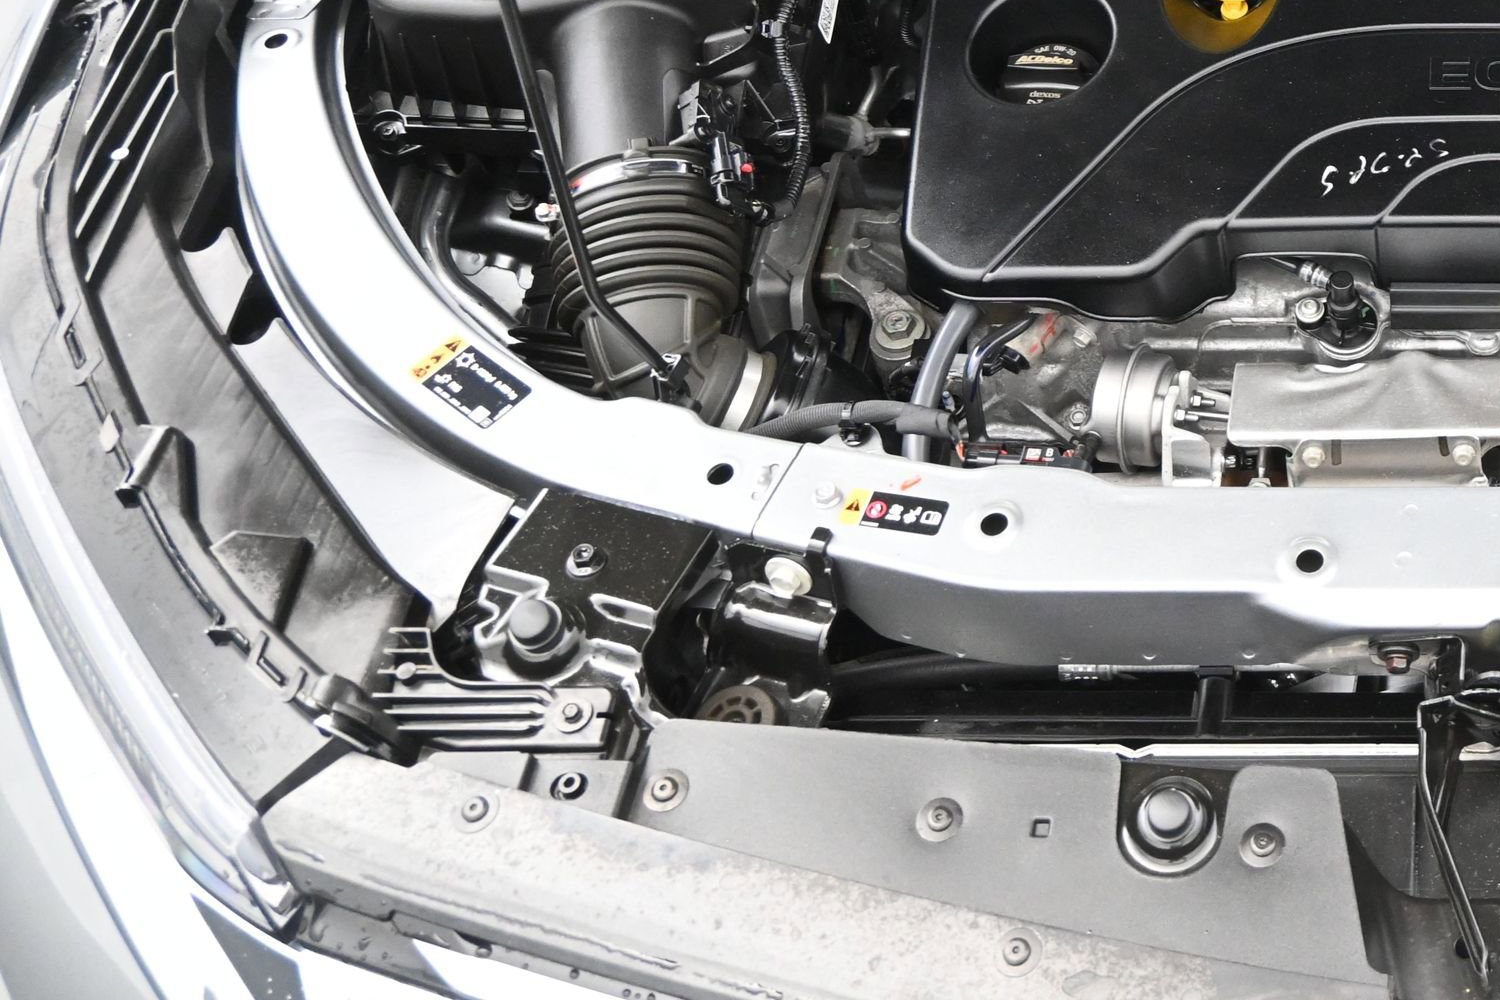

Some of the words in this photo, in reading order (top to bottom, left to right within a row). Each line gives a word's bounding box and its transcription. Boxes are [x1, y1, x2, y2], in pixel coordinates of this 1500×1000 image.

[1034, 45, 1050, 54] SAE
[1014, 55, 1074, 65] ACDelco
[1029, 90, 1062, 99] dexos
